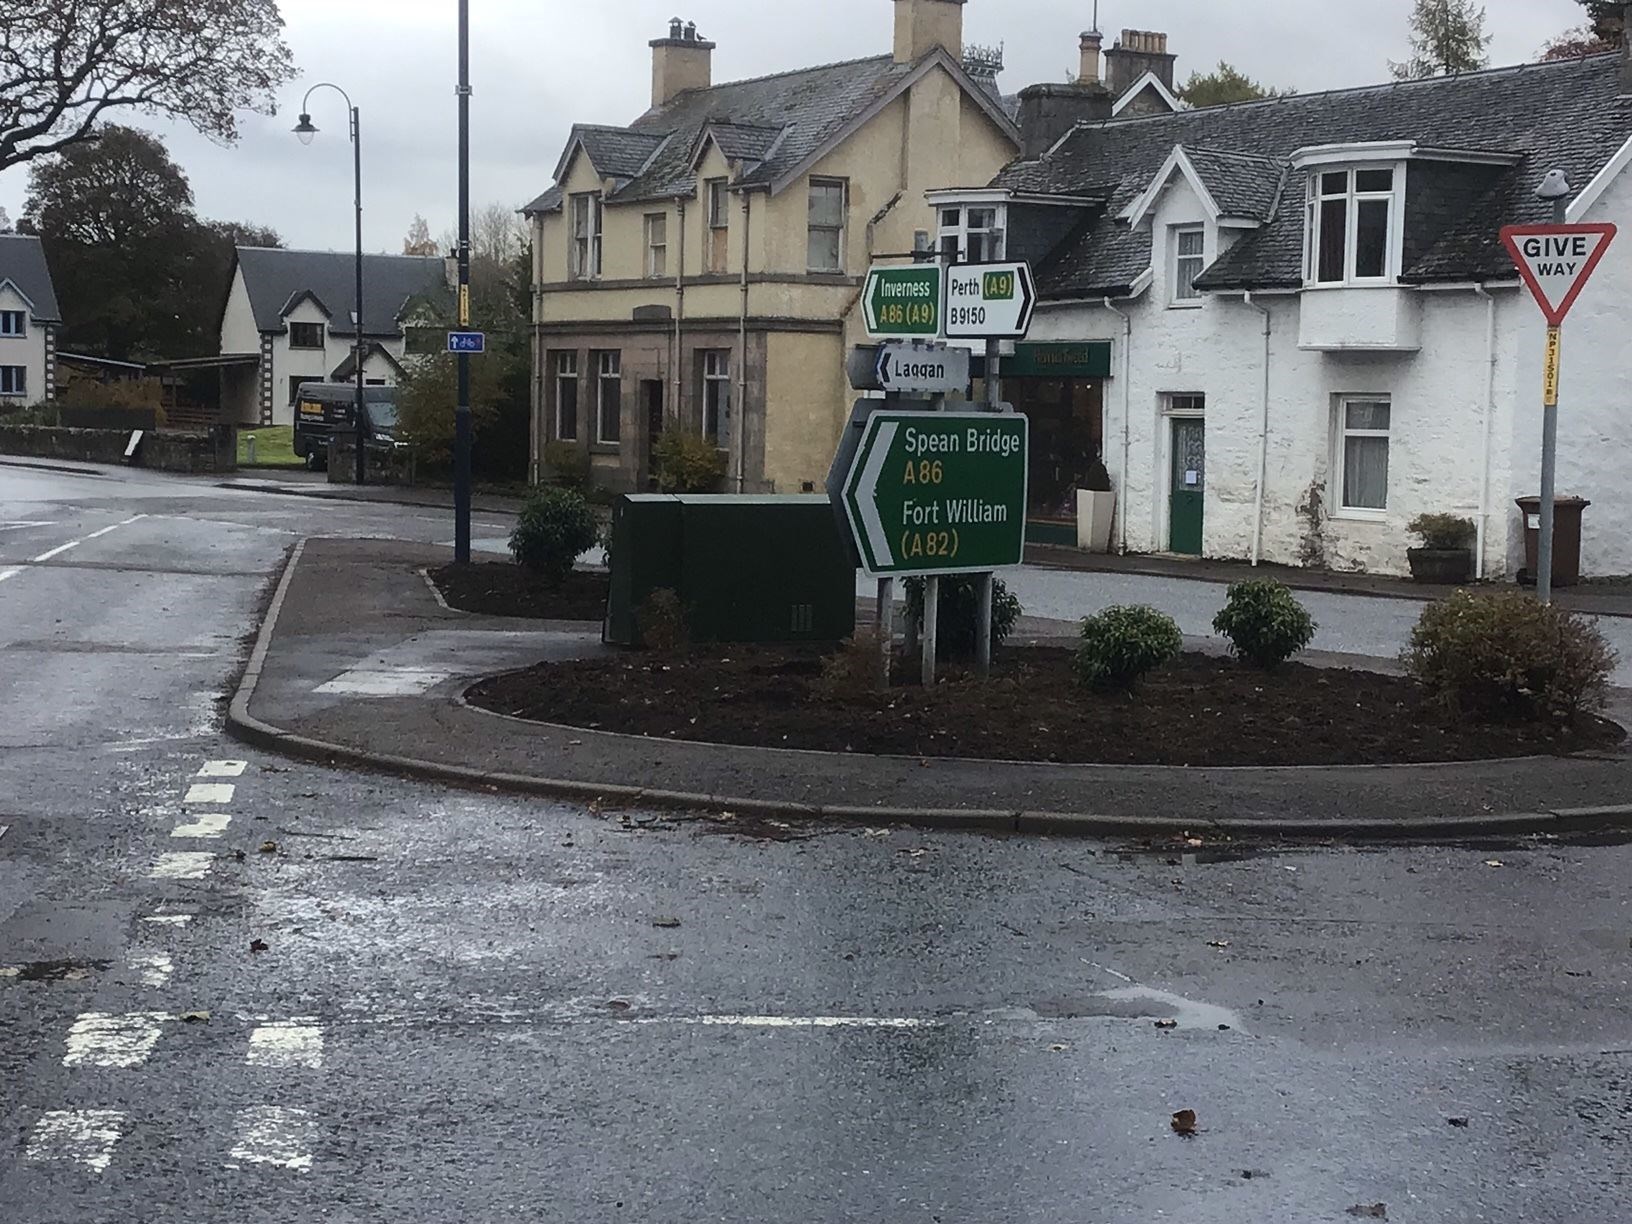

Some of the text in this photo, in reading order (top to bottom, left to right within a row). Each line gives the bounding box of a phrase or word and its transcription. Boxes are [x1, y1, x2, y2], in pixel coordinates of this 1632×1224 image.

[1523, 237, 1587, 258] GIVE
[1538, 262, 1577, 276] WAY
[881, 278, 930, 298] Inverness
[951, 273, 1014, 297] Perth (A9)
[879, 302, 934, 325] A86 (A9)
[950, 307, 985, 325] B9150
[895, 360, 945, 379] Laggan
[905, 427, 1020, 457] Spean Bridge
[902, 460, 943, 484] A86
[902, 500, 1007, 525] Fort William
[901, 528, 959, 560] (A82)
